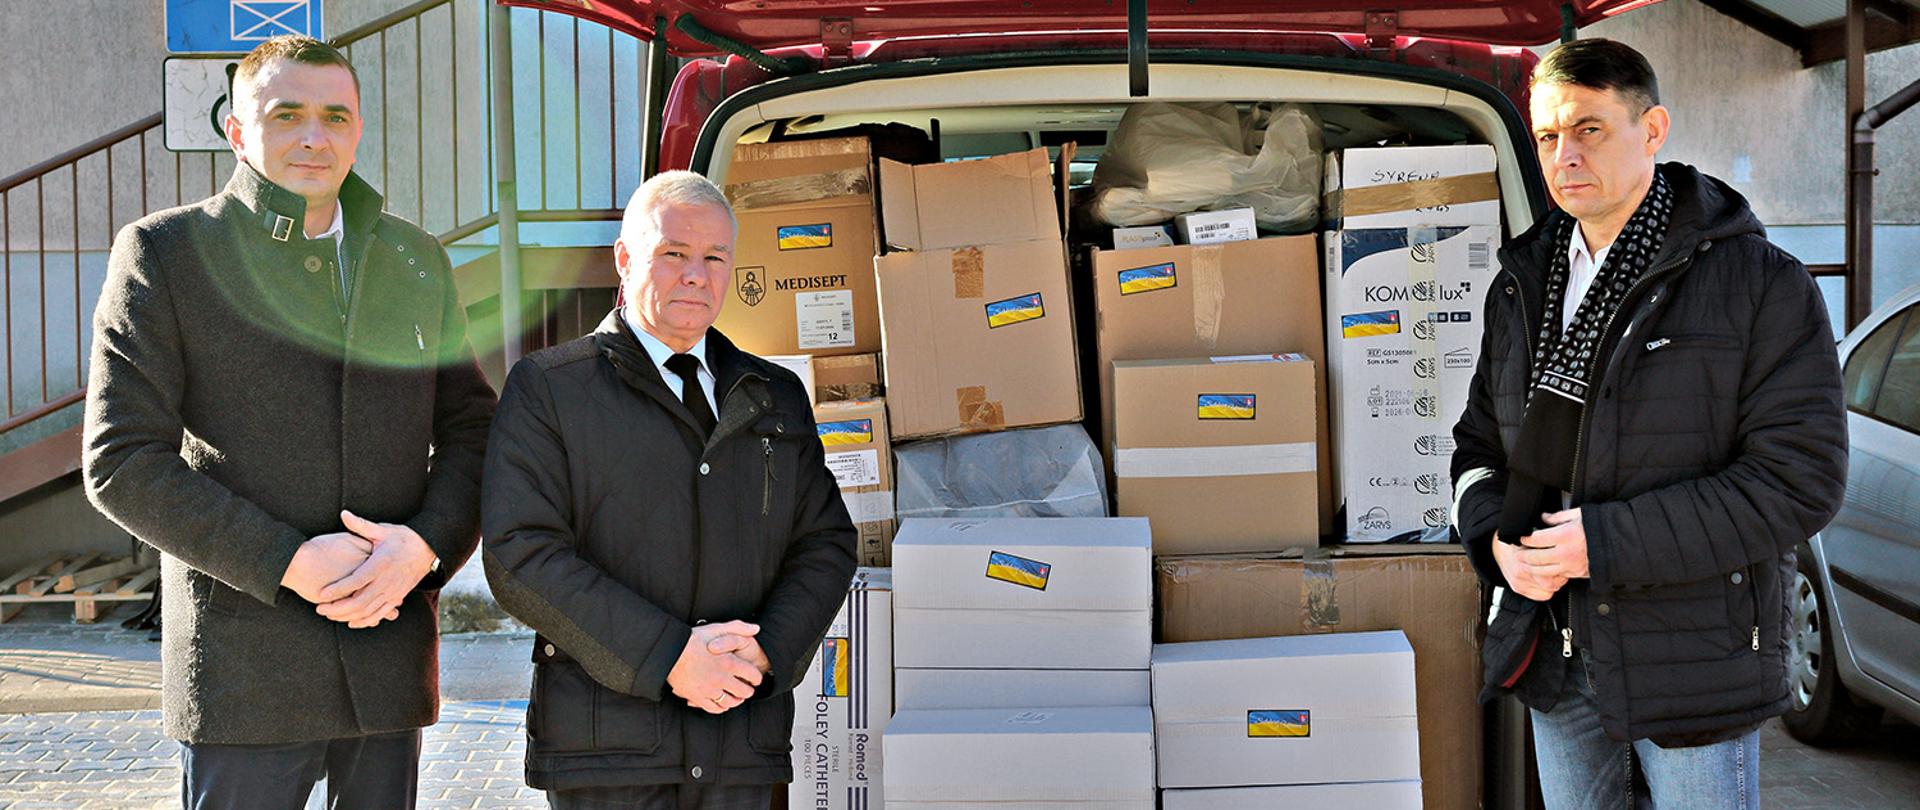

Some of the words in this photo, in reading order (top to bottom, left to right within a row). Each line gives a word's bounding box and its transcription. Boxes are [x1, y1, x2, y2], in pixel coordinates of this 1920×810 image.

[775, 275, 847, 291] MEDISEPT
[828, 332, 838, 340] 12
[1428, 357, 1436, 379] ZARYS
[1428, 395, 1436, 418] ZARYS
[1429, 434, 1437, 456] ZARYS
[1364, 520, 1392, 530] ZARYS
[816, 693, 828, 739] FOLEY
[804, 755, 812, 780] PIECES
[856, 733, 869, 781] Romed
